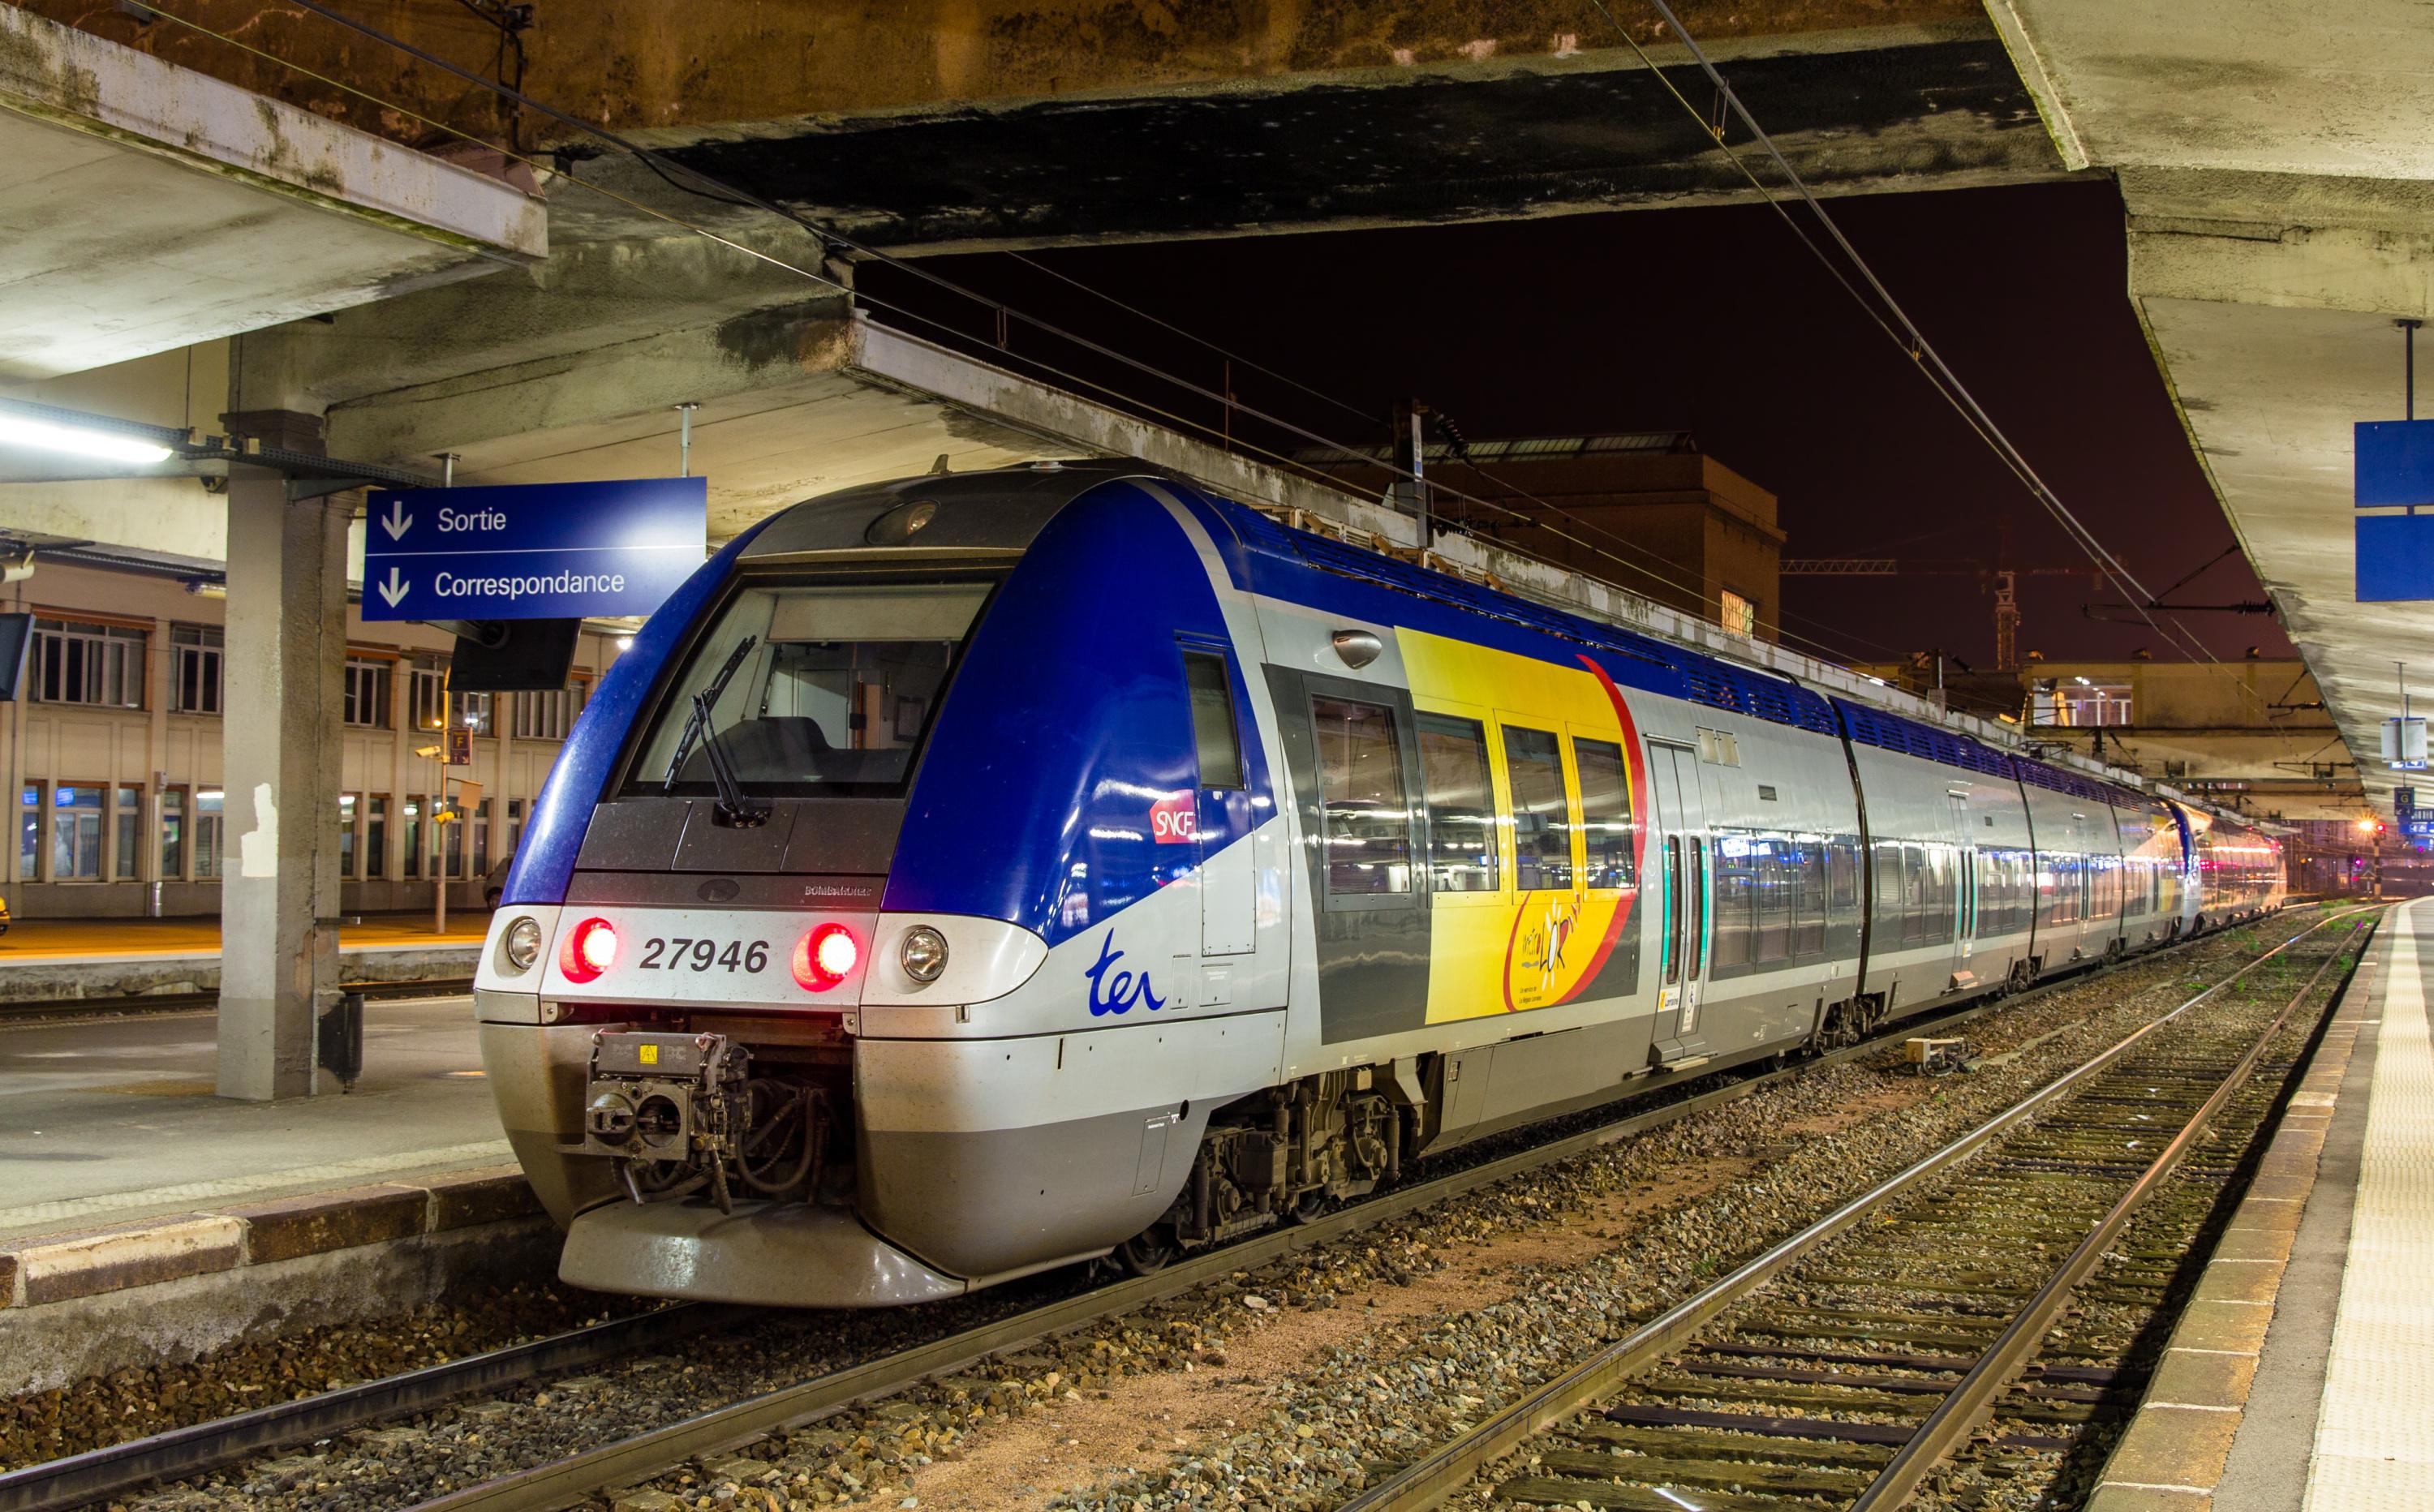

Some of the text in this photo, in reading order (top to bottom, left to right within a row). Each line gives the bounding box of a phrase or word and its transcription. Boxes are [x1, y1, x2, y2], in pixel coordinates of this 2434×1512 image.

[438, 508, 506, 531] Sortie
[435, 569, 625, 599] Correspondance
[456, 737, 463, 747] F
[2401, 795, 2409, 803] G
[1155, 811, 1194, 836] SNCF
[805, 886, 872, 896] BOMBARDIER
[639, 938, 769, 973] 27946
[1086, 927, 1167, 1017] ter
